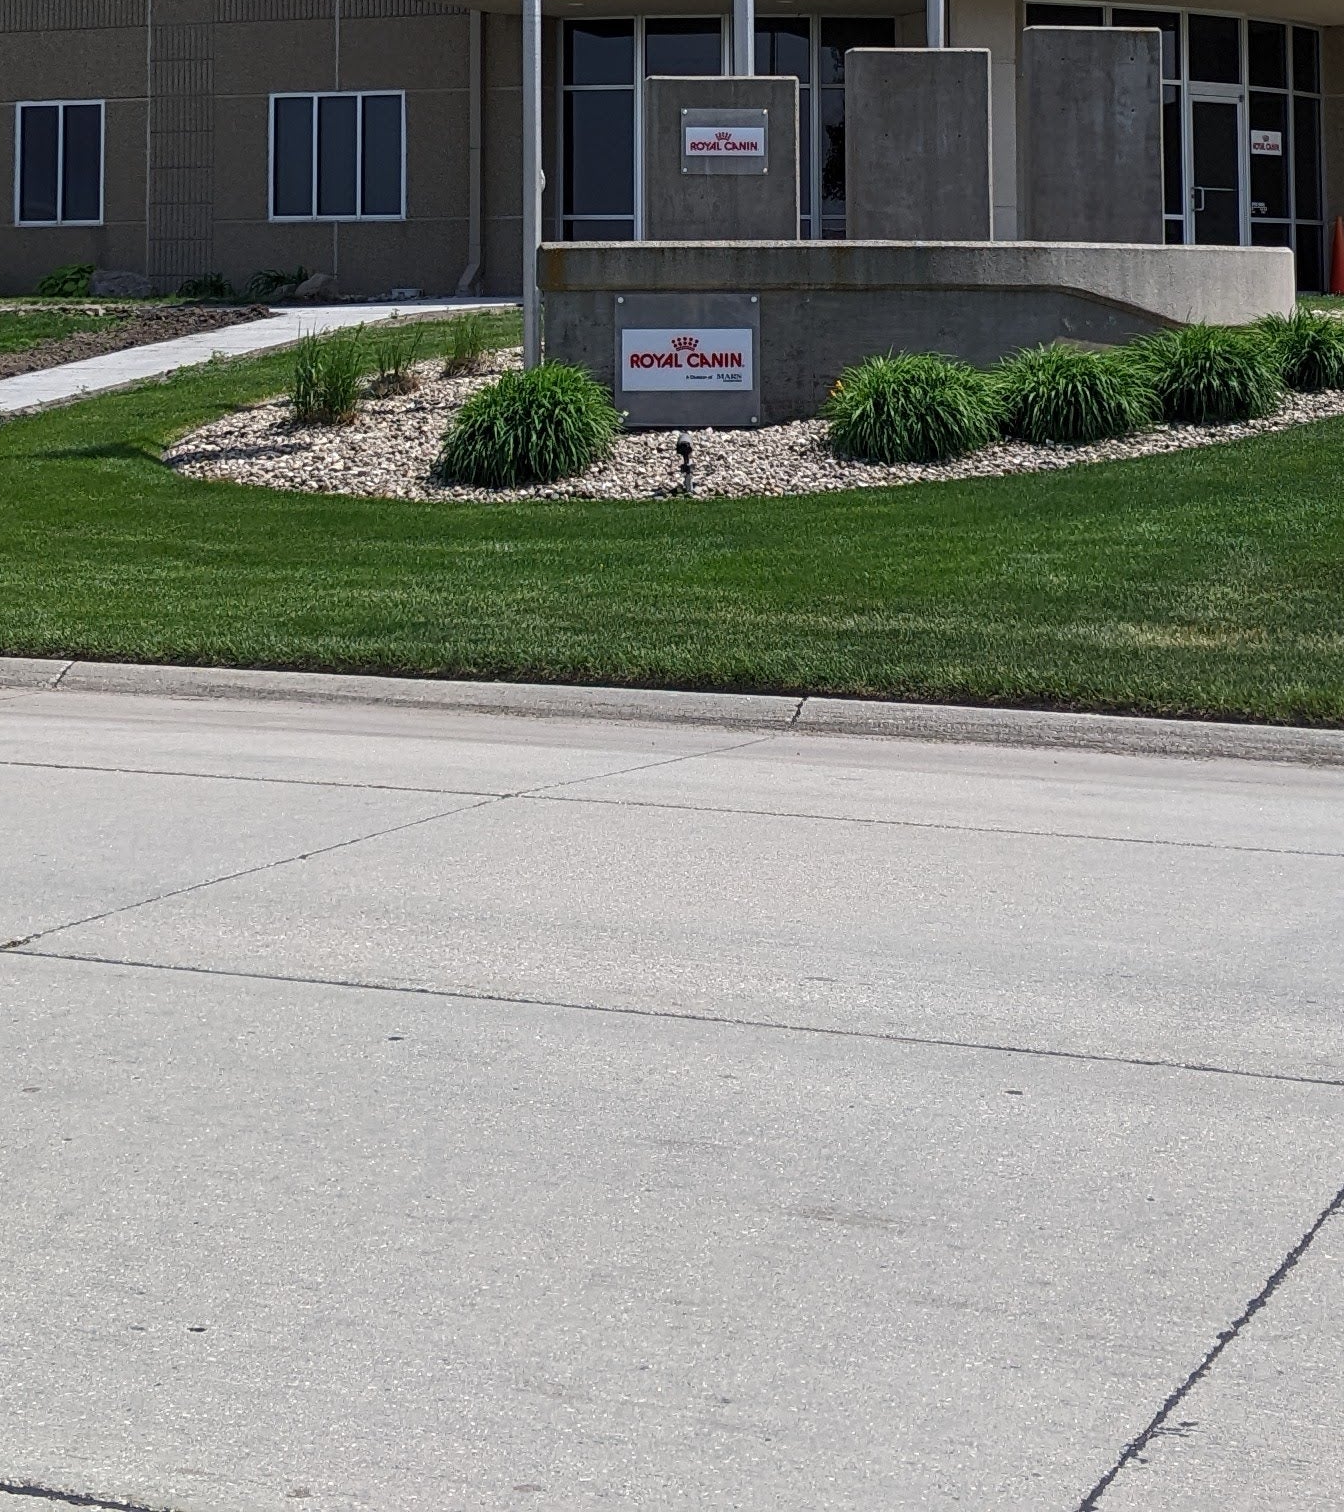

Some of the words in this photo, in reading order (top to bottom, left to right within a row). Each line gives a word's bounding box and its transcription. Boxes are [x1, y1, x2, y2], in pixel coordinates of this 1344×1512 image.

[690, 141, 722, 151] ROYAL
[724, 141, 758, 151] CANIN
[630, 352, 683, 369] ROYAL
[686, 352, 742, 369] CANIN
